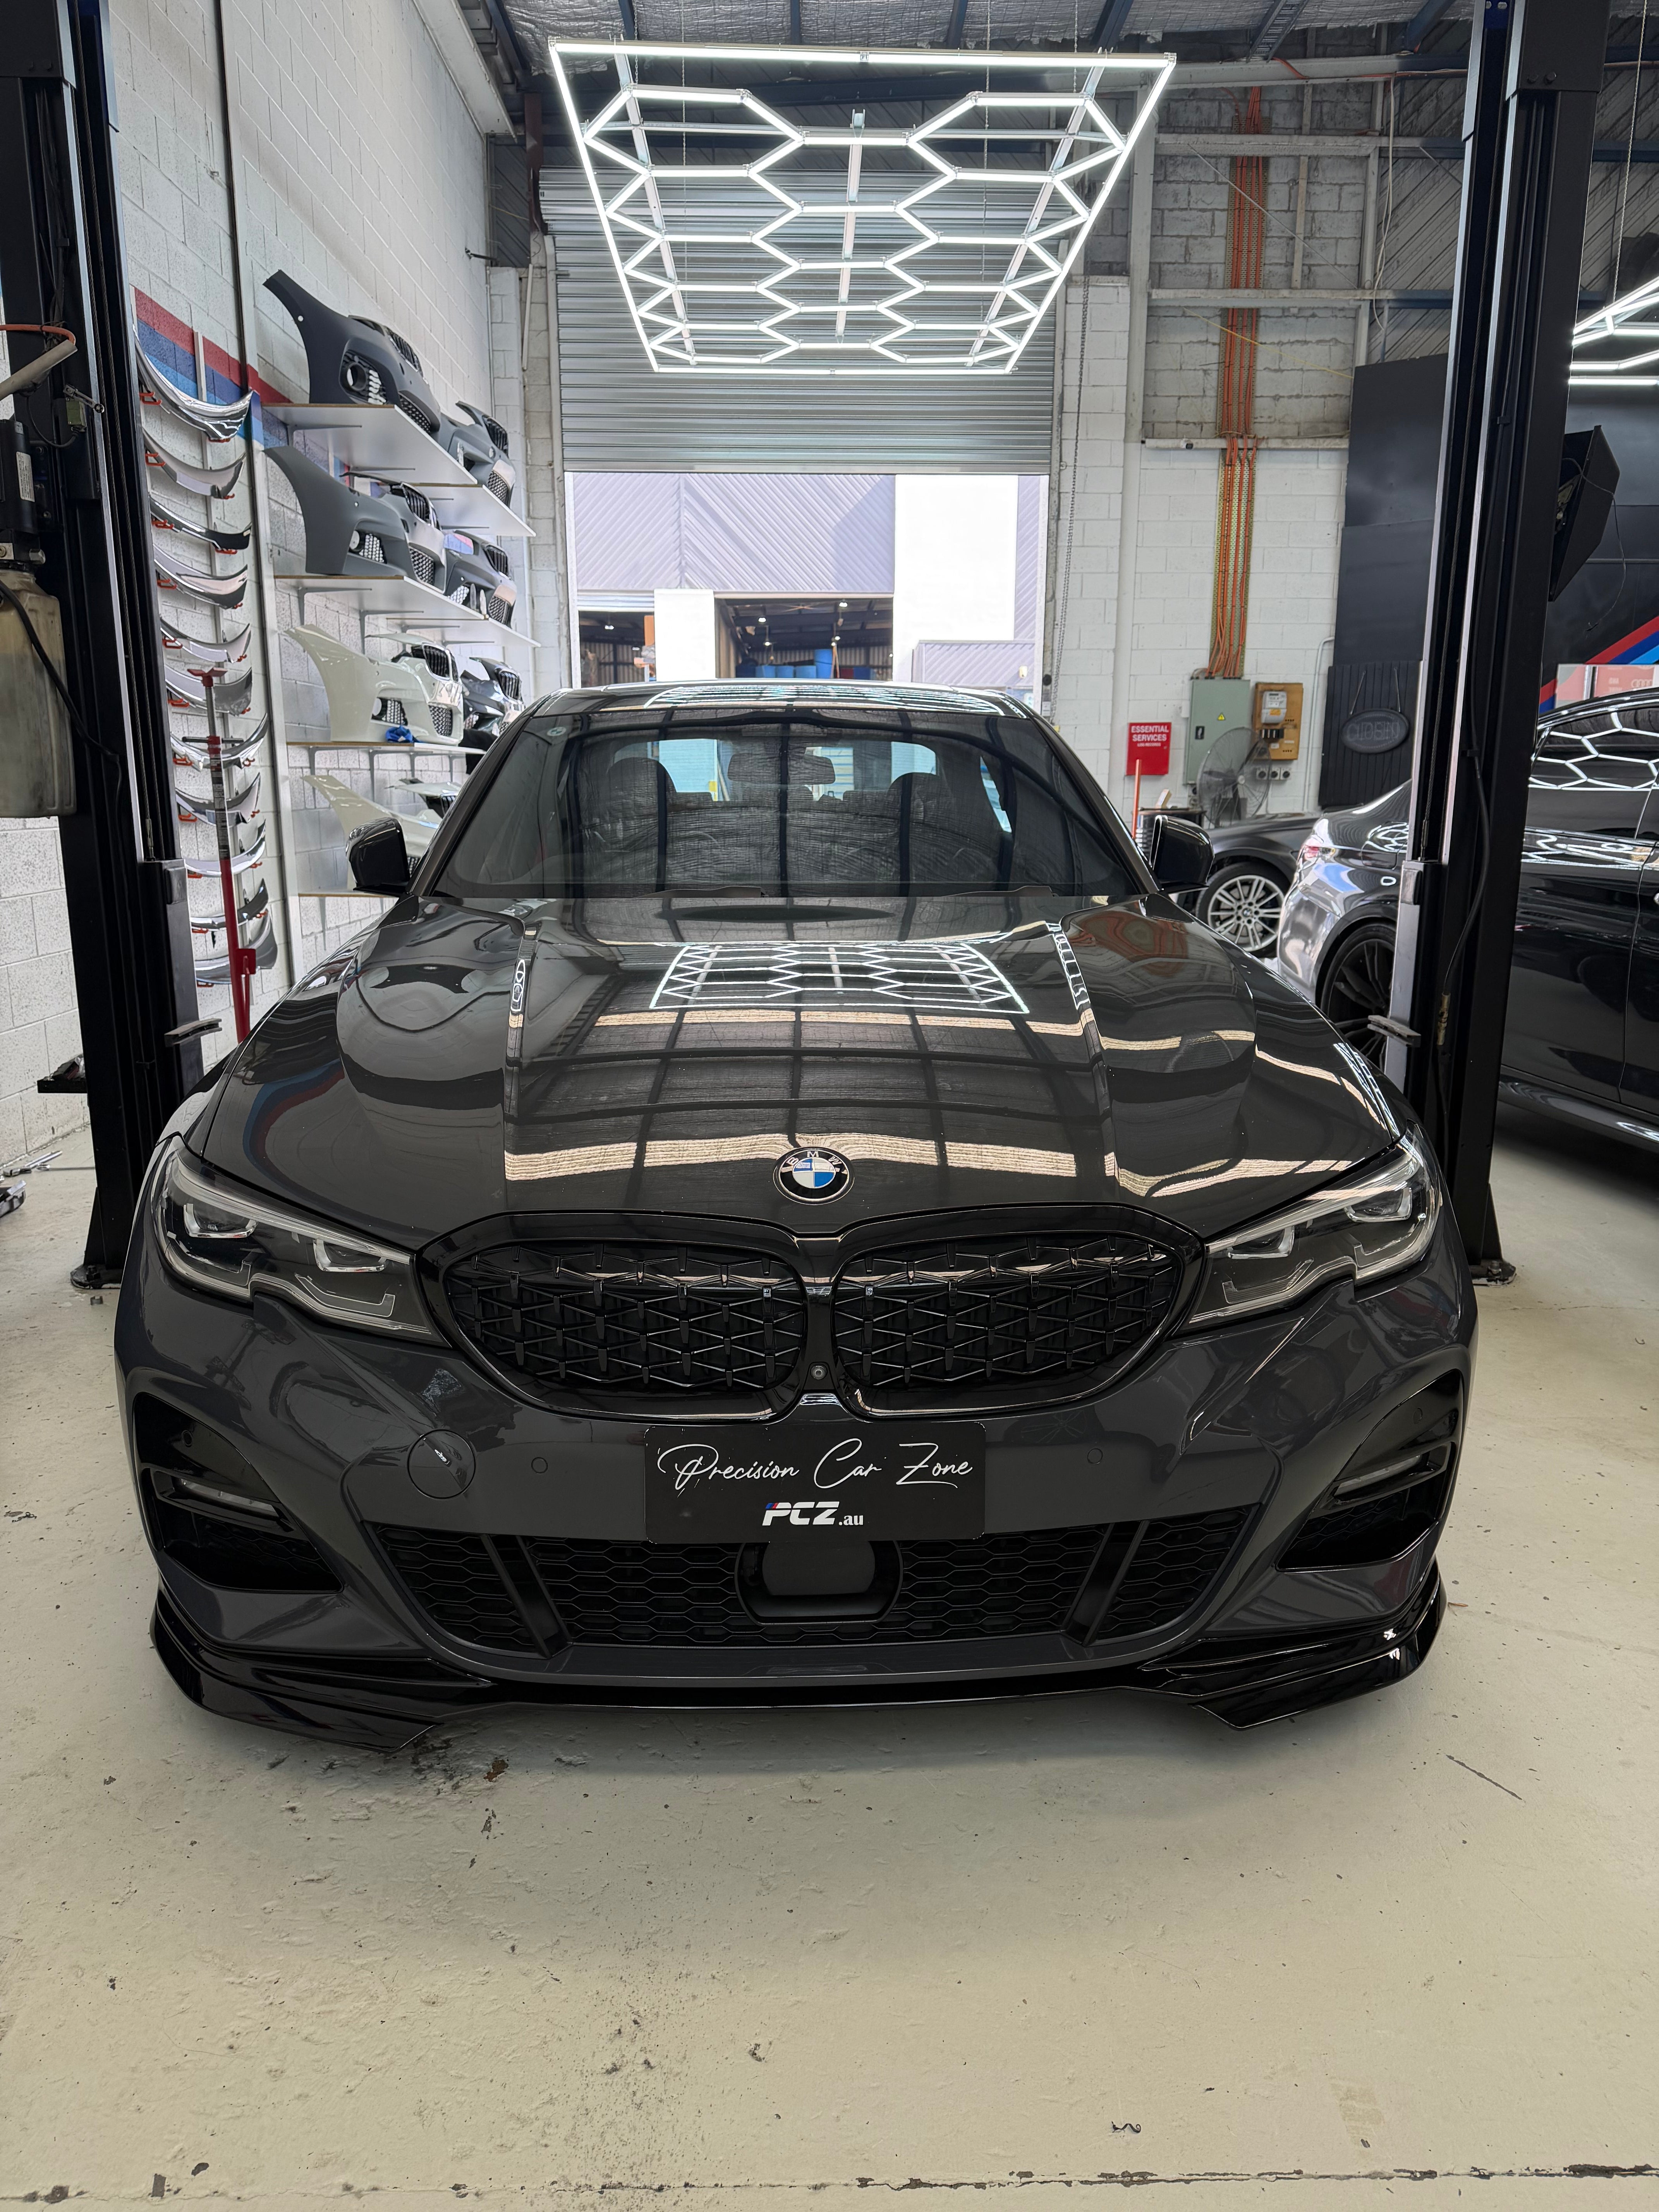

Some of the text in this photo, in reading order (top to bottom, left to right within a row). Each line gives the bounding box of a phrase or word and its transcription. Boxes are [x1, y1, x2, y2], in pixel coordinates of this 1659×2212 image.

[786, 1151, 842, 1165] BMW
[657, 1438, 973, 1490] Precision Car Zone
